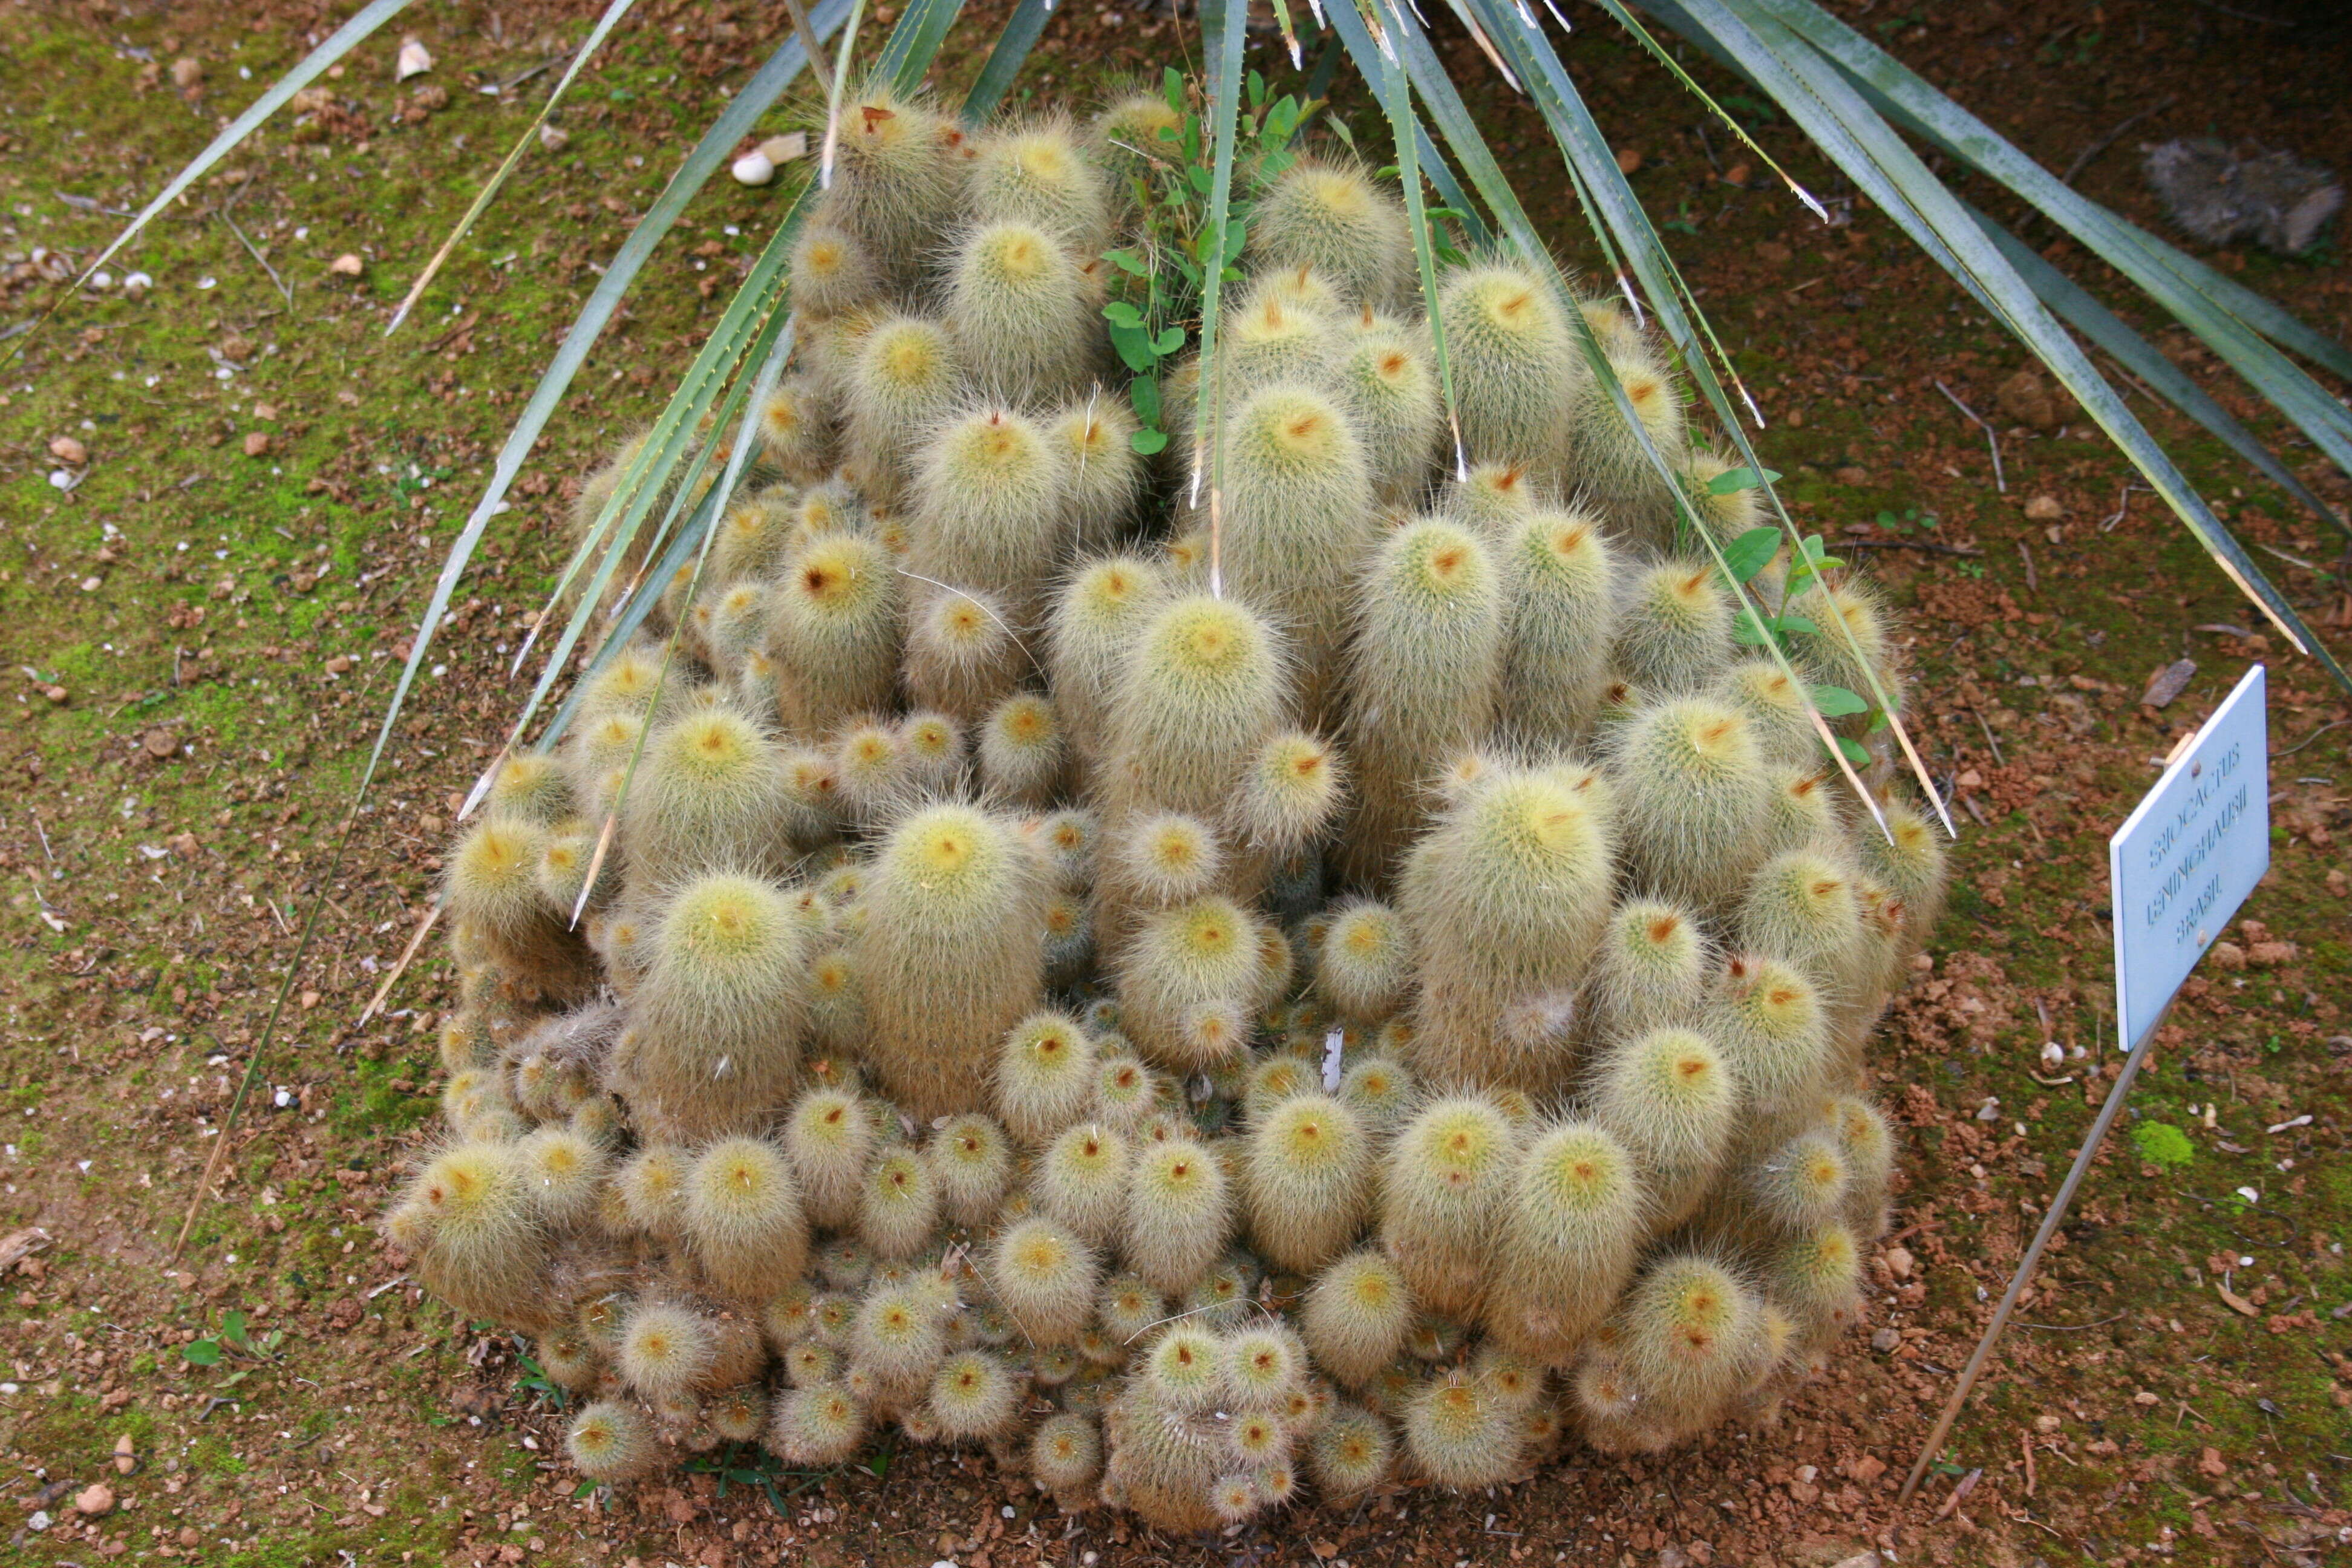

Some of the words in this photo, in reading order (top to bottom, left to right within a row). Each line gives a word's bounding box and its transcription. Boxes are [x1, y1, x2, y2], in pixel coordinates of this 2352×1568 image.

[2147, 783, 2247, 926] LENINGHAUSII
[2149, 742, 2240, 869] ERIOCACTUS
[2177, 874, 2222, 944] BRASIL
